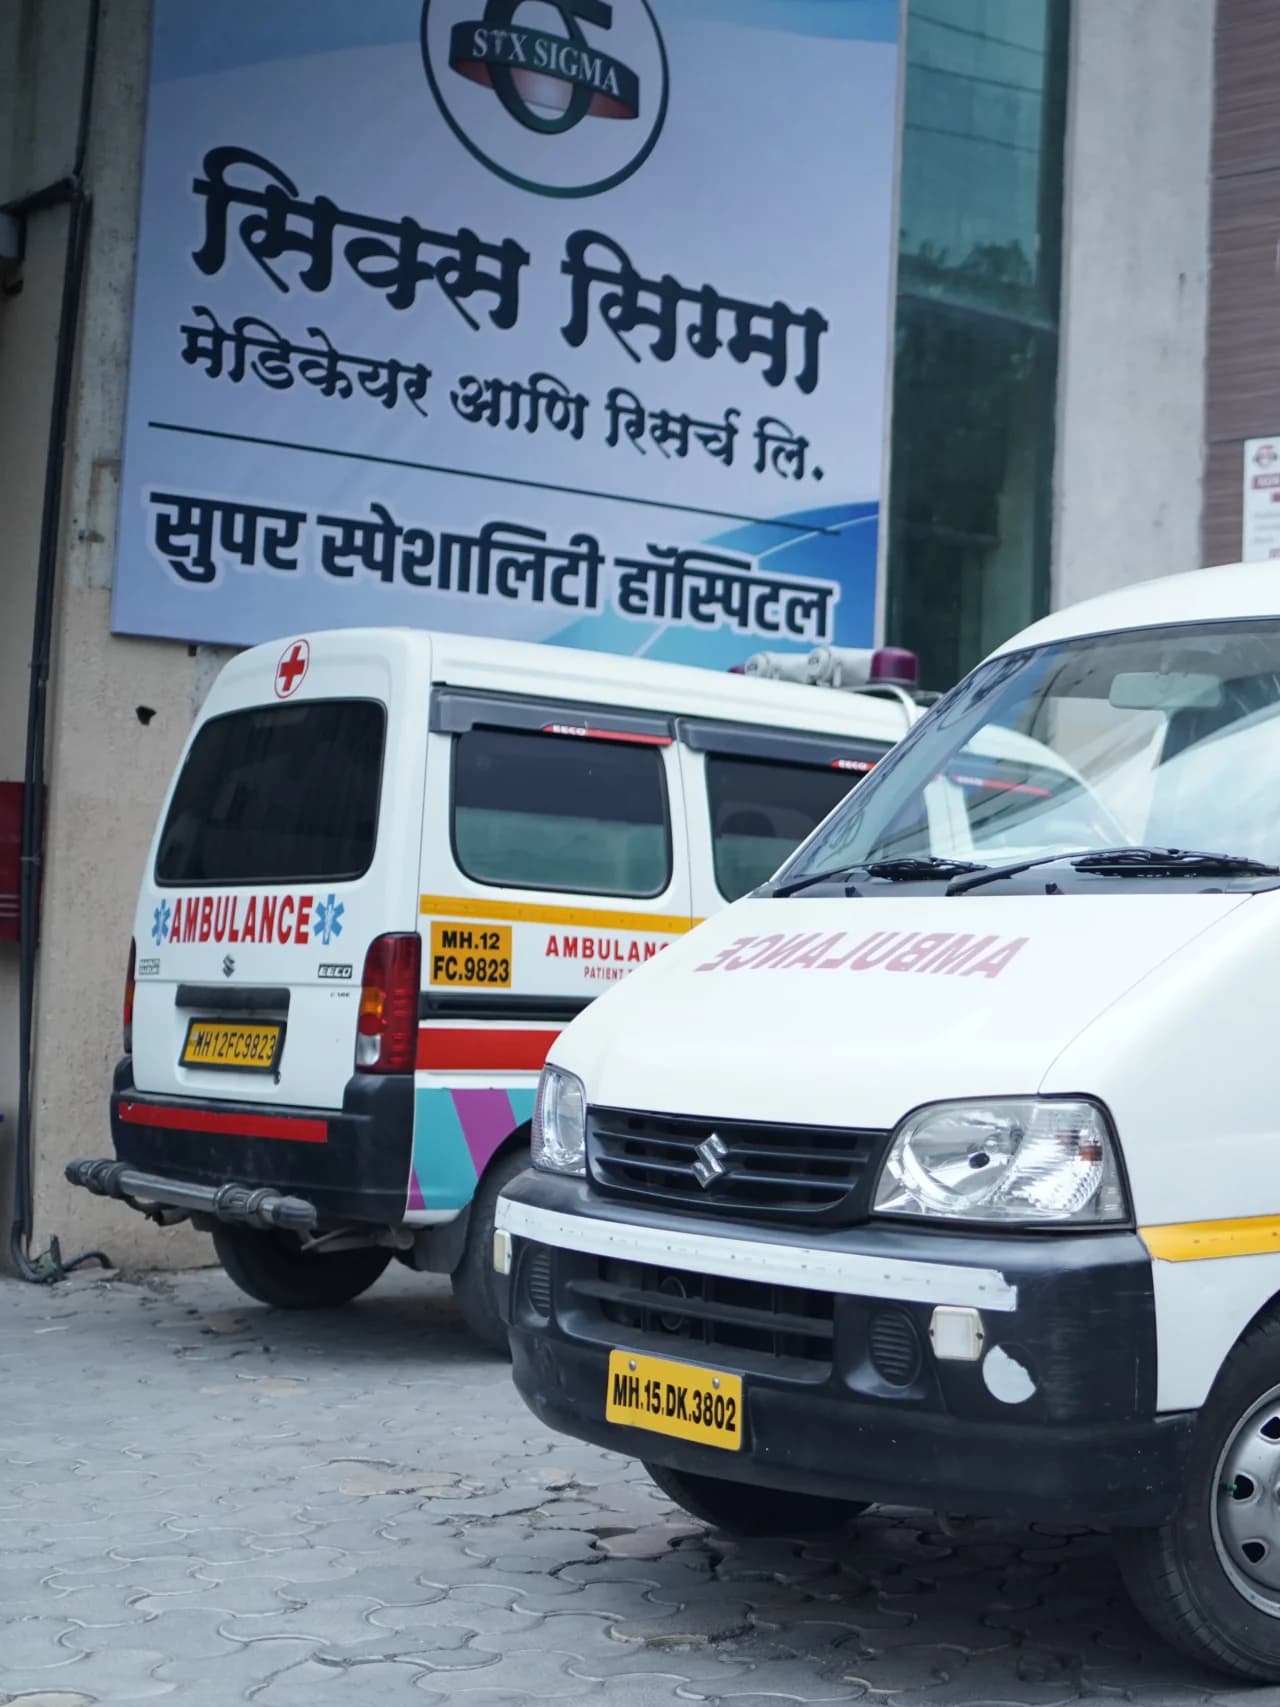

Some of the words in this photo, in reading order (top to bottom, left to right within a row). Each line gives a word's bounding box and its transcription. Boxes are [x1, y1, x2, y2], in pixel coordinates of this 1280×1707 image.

[534, 38, 620, 96] SIGMA
[193, 146, 529, 330] सिक्स
[561, 229, 829, 394] सिग्मा
[181, 306, 431, 418] मेडिकेयर
[450, 373, 588, 441] आणि
[606, 388, 739, 467] रिसर्च
[754, 416, 824, 483] लि.
[149, 492, 308, 585] सुपर
[317, 503, 605, 611] स्पेशालिटी
[615, 543, 834, 639] हॉस्पिटल
[168, 895, 314, 945] AMBULANCE
[441, 930, 501, 950] MH.12
[318, 965, 352, 978] EECO
[433, 956, 510, 983] FC.9823
[584, 966, 623, 980] PATIENT
[193, 1031, 277, 1061] MH12FC9823
[613, 1373, 736, 1432] MH.15.DK.3802
